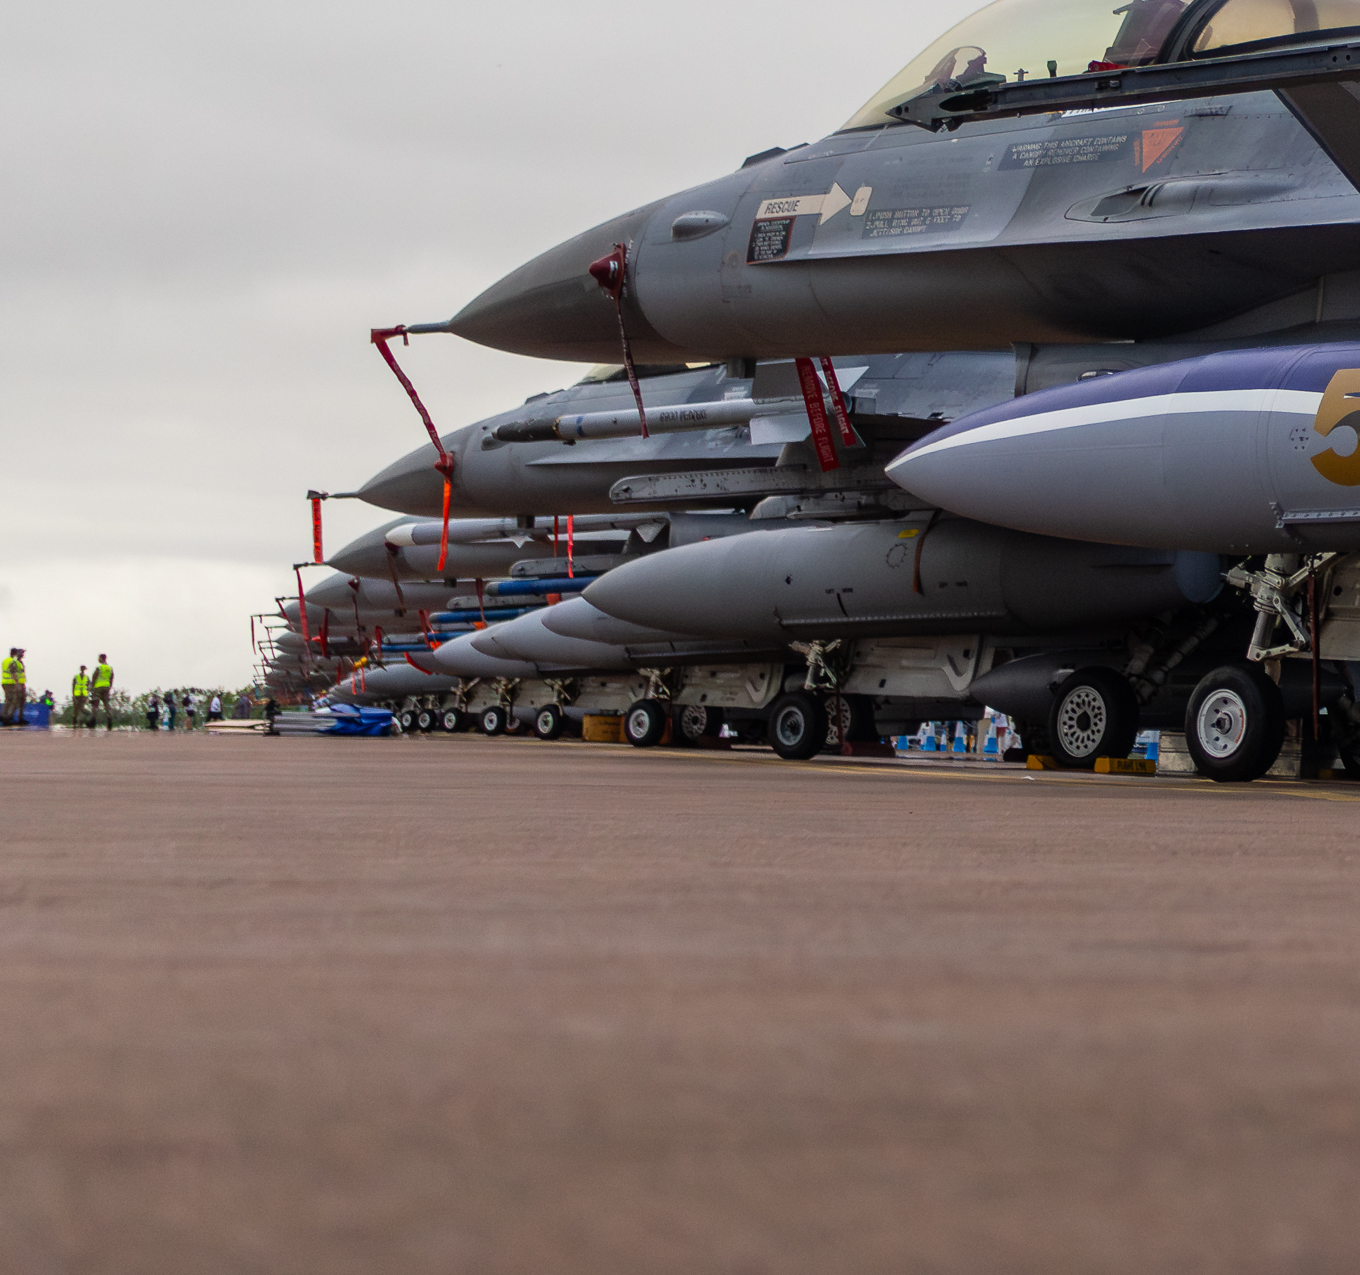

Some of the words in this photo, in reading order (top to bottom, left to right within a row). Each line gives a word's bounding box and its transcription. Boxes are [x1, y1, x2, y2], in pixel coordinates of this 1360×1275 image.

[1043, 140, 1058, 150] THIS
[1060, 137, 1093, 148] AIRCRAFT
[1094, 135, 1128, 146] CONTAINS
[1023, 159, 1033, 167] AN
[1035, 155, 1071, 166] EXPLOSIVE
[764, 199, 800, 215] RESCUE
[800, 364, 819, 400] REMOVE
[809, 401, 827, 435] BEFORE
[817, 436, 835, 463] FLIGHT
